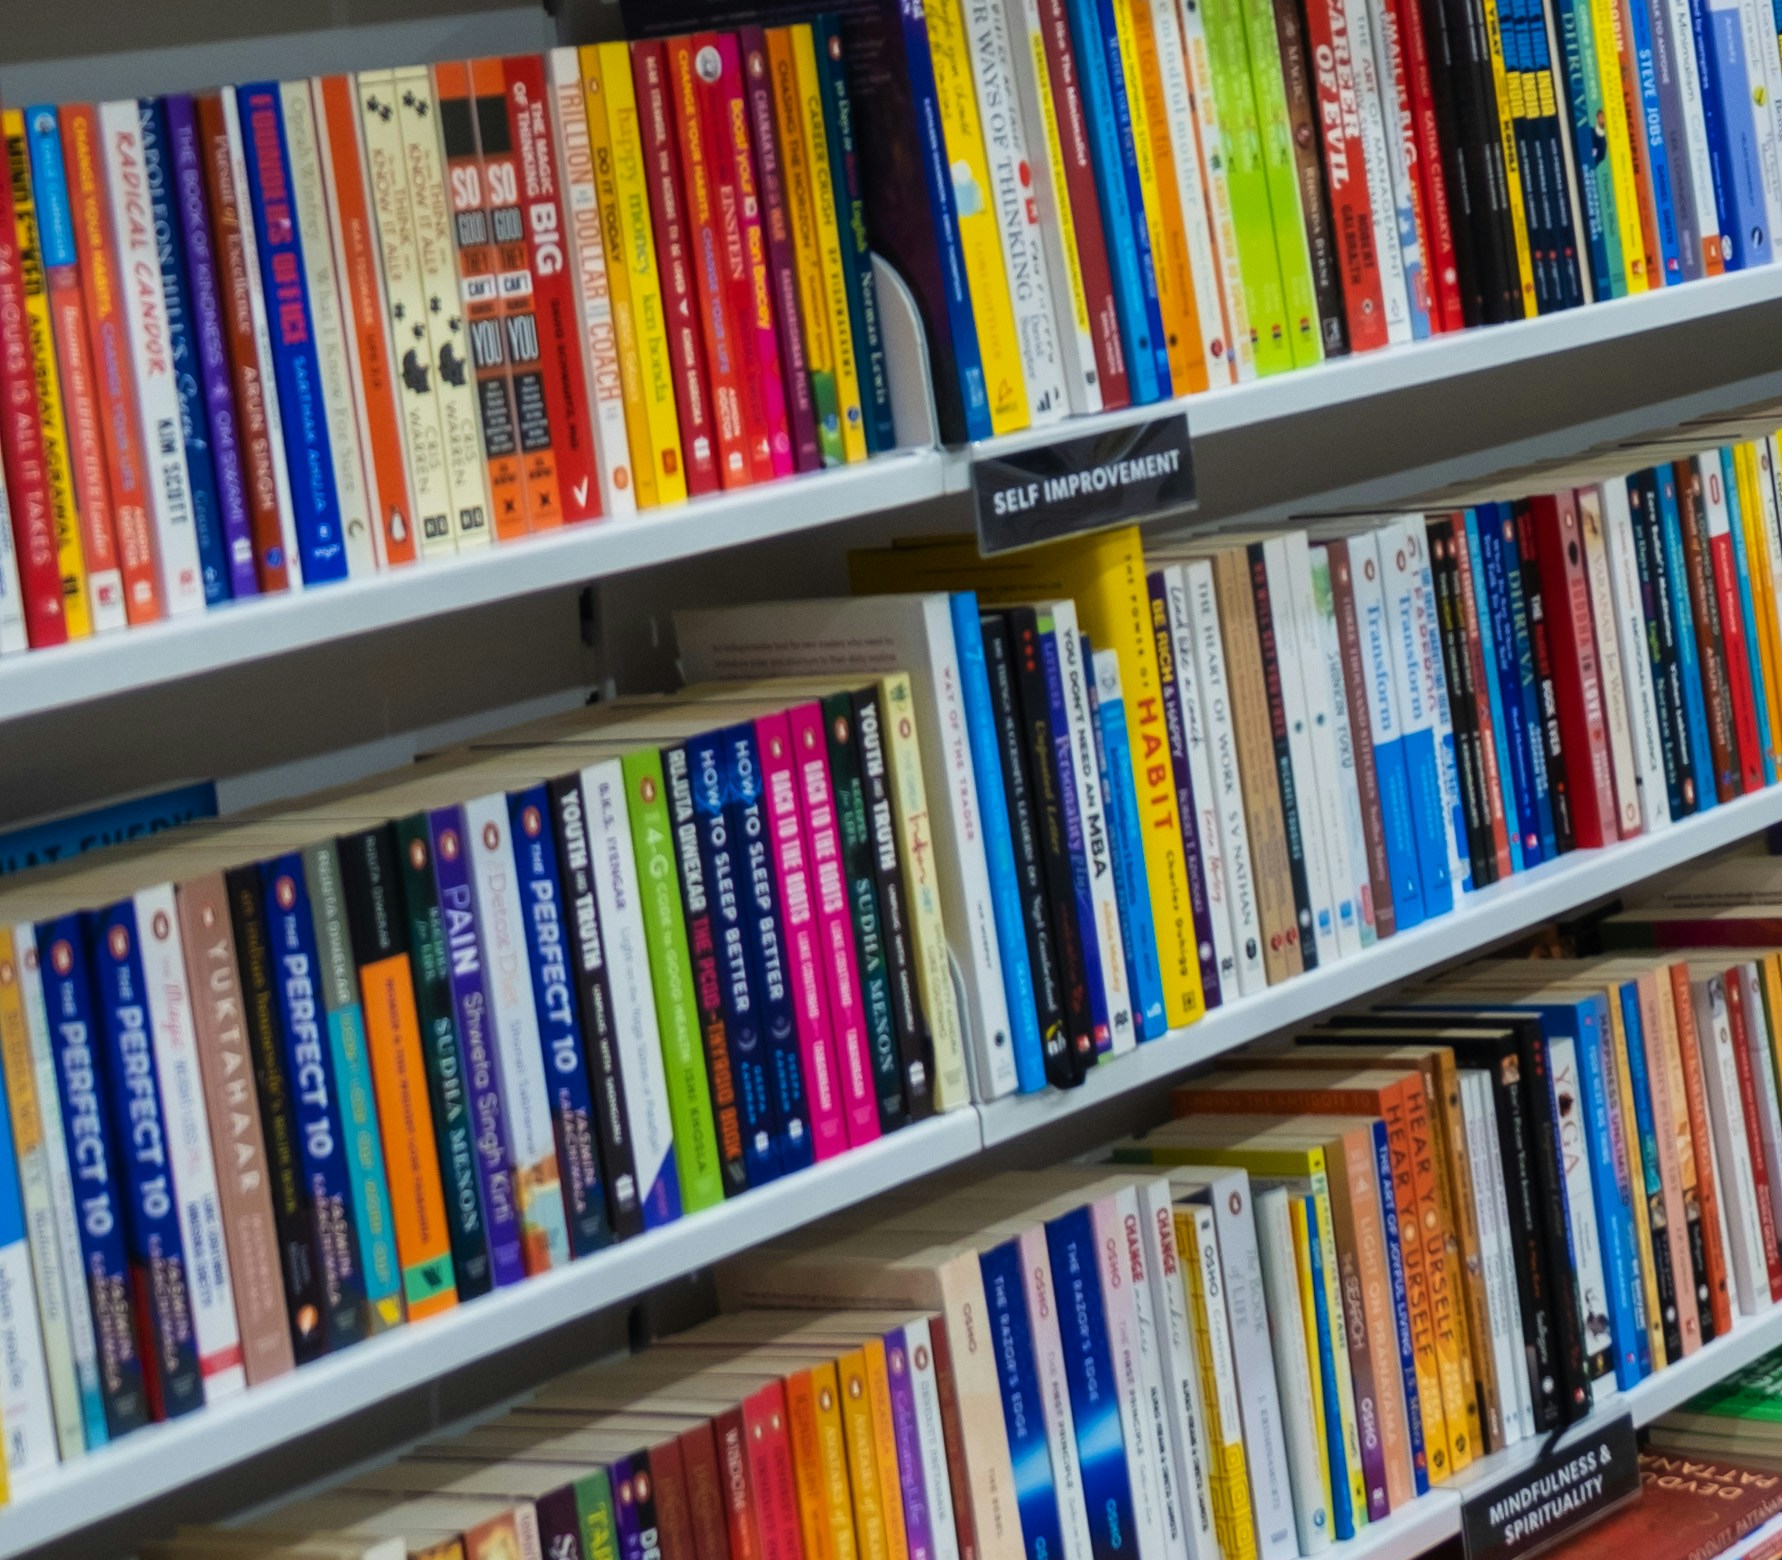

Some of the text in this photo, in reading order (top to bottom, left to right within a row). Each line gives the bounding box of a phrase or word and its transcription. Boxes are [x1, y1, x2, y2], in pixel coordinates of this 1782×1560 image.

[994, 450, 1180, 515] SELF IMPROVEMENT
[1138, 696, 1173, 831] HABIT
[282, 954, 333, 1159] PERFECT 10
[1488, 1444, 1612, 1527] MINDFULNESS &
[1503, 1475, 1604, 1547] SPIRITUALITY
